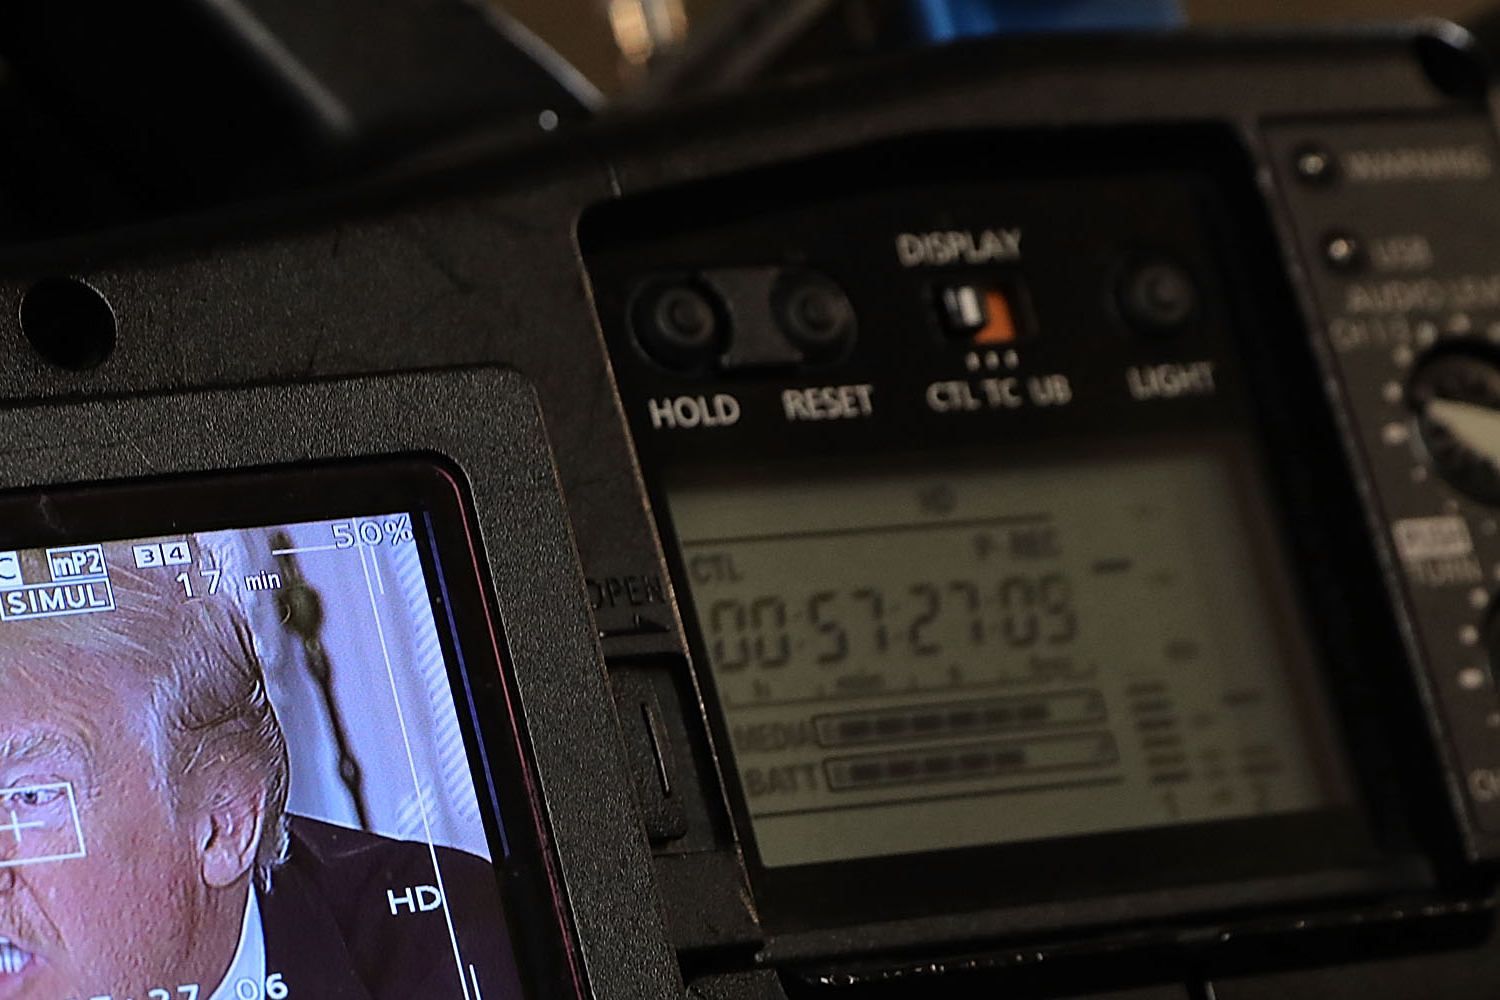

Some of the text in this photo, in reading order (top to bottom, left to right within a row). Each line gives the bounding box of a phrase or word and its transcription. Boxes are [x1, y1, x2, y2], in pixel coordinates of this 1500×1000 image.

[895, 228, 1023, 268] DISPLAY
[926, 373, 1074, 413] CTL TC UB
[1127, 360, 1216, 400] LIGHT
[649, 384, 875, 431] HOLD RESET
[331, 517, 415, 550] 50%
[140, 546, 185, 563] 3 4
[244, 569, 282, 592] min
[6, 585, 106, 615] SIMUL
[386, 885, 443, 916] HD
